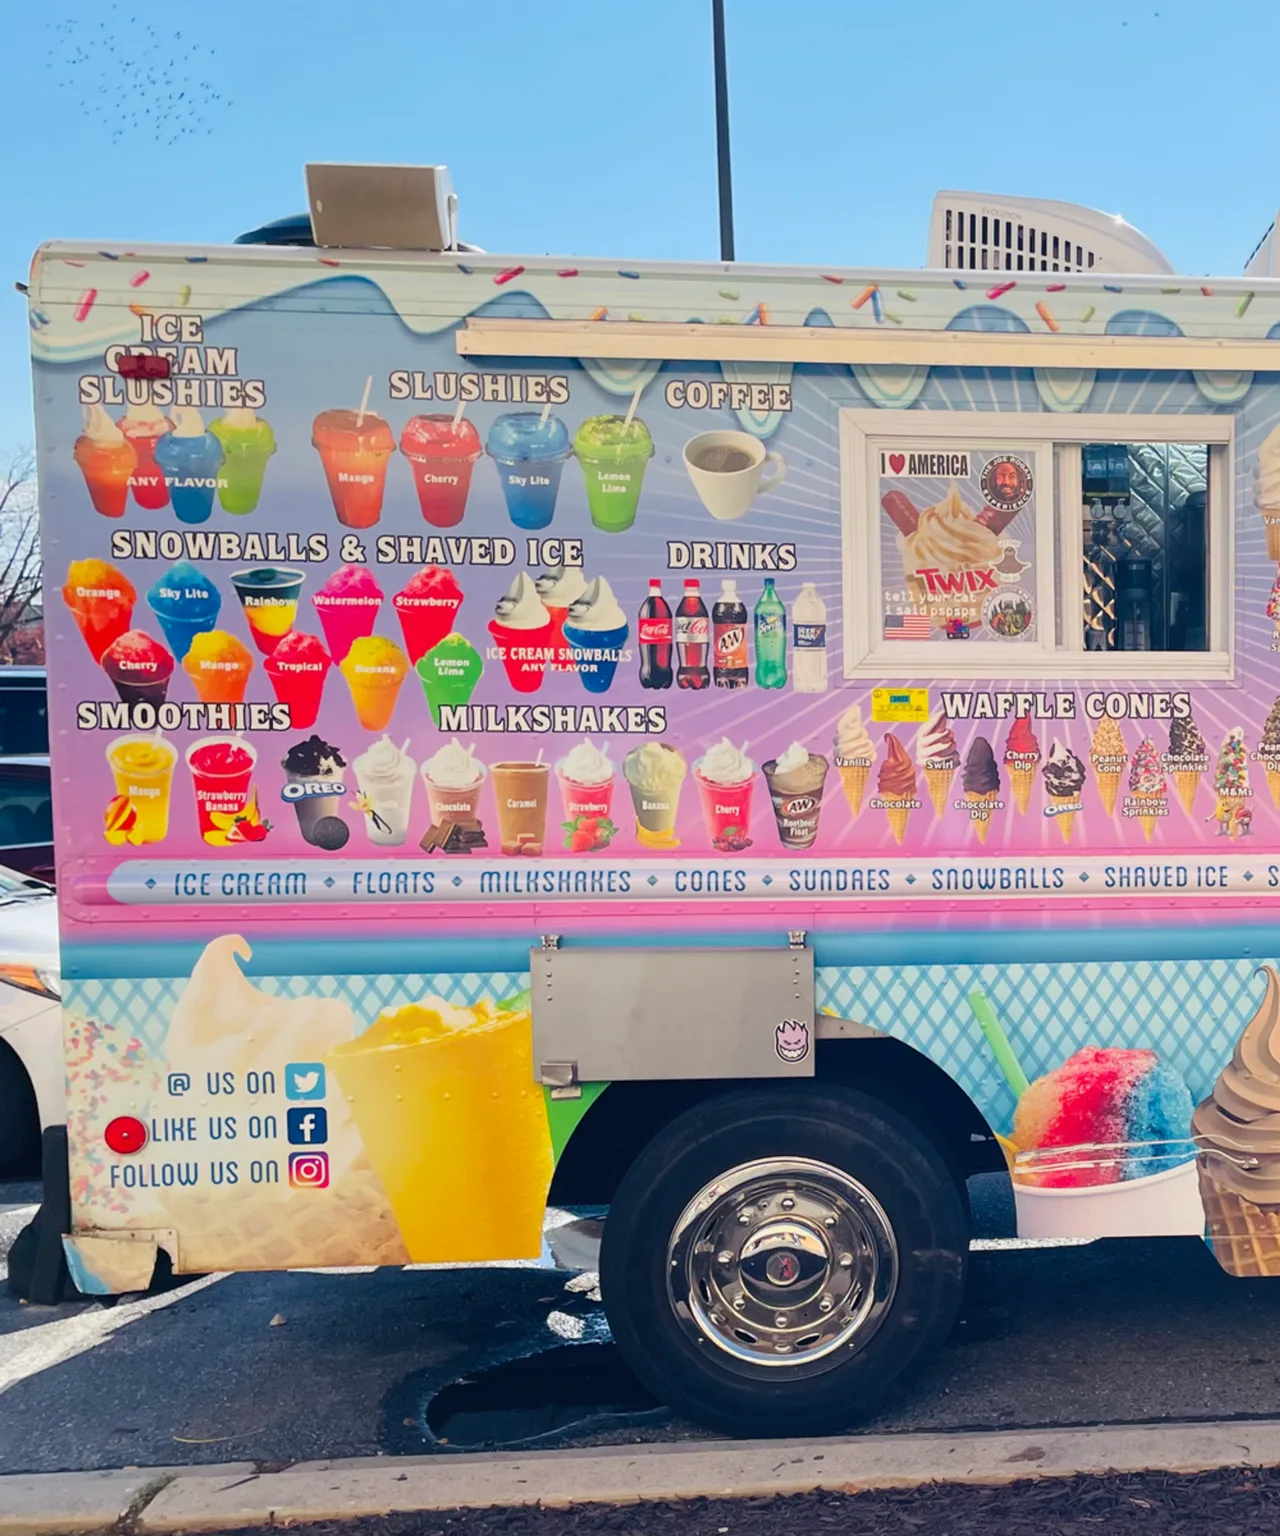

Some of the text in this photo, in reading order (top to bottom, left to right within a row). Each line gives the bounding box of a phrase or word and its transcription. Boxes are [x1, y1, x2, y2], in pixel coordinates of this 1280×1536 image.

[141, 314, 203, 344] ICE
[78, 375, 266, 408] SLUSHIES
[389, 370, 570, 404] SLUSHIES
[666, 380, 793, 411] COFFEE
[881, 453, 969, 476] I AMERICA
[338, 472, 374, 484] Mango
[424, 473, 458, 485] Cherry
[509, 475, 550, 487] Sky Lite
[597, 471, 631, 482] Lemon
[126, 476, 229, 490] ANY FLAVOR
[602, 483, 627, 494] Lime
[111, 530, 584, 567] SNOWBALLS & SHAVED ICE
[667, 541, 798, 571] DRINKS
[76, 587, 121, 599] Orange
[159, 587, 209, 601] Sky Lite
[884, 590, 977, 604] tell your cat
[244, 596, 296, 607] Rainbow
[313, 595, 382, 606] Watermelon
[395, 596, 460, 608] Strawberry
[895, 604, 977, 618] said pspsps
[487, 647, 633, 662] ICE CREAM SNOWBALLS
[119, 660, 158, 672] Cherry
[200, 660, 239, 672] Mango
[277, 661, 323, 673] Tropical
[434, 657, 470, 667] Lemon
[520, 663, 599, 673] ANY FLAVOR
[438, 667, 465, 677] Lime
[942, 692, 1076, 719] WAFFLE
[1084, 692, 1192, 719] CONES
[77, 702, 292, 731] SMOOTHIES
[438, 704, 667, 733] MILKSHAKES
[1006, 750, 1040, 761] Cherry
[1092, 754, 1128, 764] Peanut
[1160, 753, 1210, 763] Chocolate
[835, 757, 871, 767] Vanilla
[926, 760, 954, 770] Swirl
[1014, 760, 1032, 771] Dip
[1097, 764, 1122, 773] Cone
[1162, 763, 1209, 774] Sprinkles
[128, 785, 161, 799] Mango
[197, 789, 247, 803] Strawberry
[282, 782, 346, 800] OREO
[204, 801, 239, 812] Banana
[435, 802, 472, 812] Chocolate
[507, 799, 537, 809] Caramel
[569, 802, 608, 814] Strawberry
[642, 801, 669, 811] Banana
[869, 799, 922, 809] Chocolate
[953, 800, 1005, 810] Chocolate
[1124, 797, 1168, 807] Rainbow
[715, 804, 740, 816] Cherry
[970, 810, 988, 820] Dip
[1122, 806, 1169, 817] Sprinkles
[352, 871, 435, 894] FLOATS
[480, 870, 632, 893] MILKSHAKES
[675, 869, 747, 892] CONES
[789, 869, 890, 891] SUNDAES
[932, 867, 1065, 891] SNOWBALLS
[1105, 866, 1228, 888] SHAVED ICE
[173, 872, 307, 896] ICE CREAM
[167, 1070, 275, 1097] @ US ON
[152, 1117, 197, 1142] LIKE
[208, 1116, 238, 1140] US
[248, 1115, 277, 1138] ON
[110, 1160, 279, 1188] FOLLOW US ON
